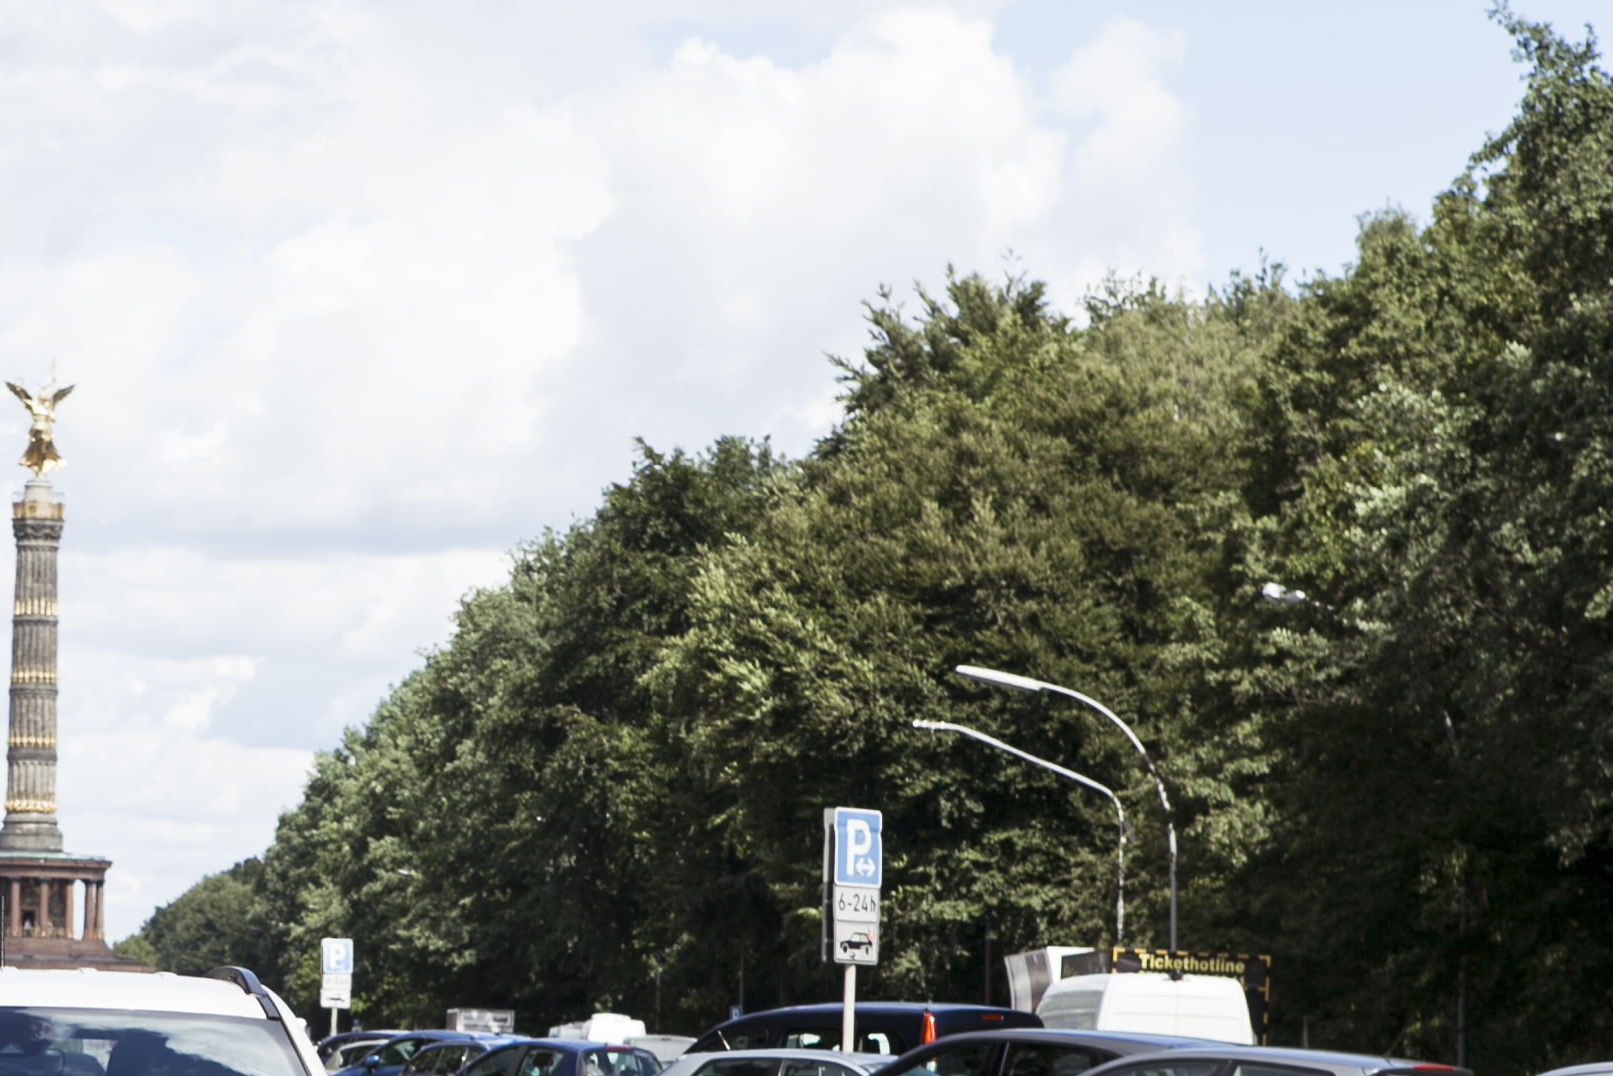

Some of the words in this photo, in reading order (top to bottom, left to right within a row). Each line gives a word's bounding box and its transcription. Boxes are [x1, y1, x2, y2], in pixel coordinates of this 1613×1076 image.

[846, 818, 872, 876] P
[330, 943, 346, 970] P
[1139, 953, 1246, 973] Tickethotline
